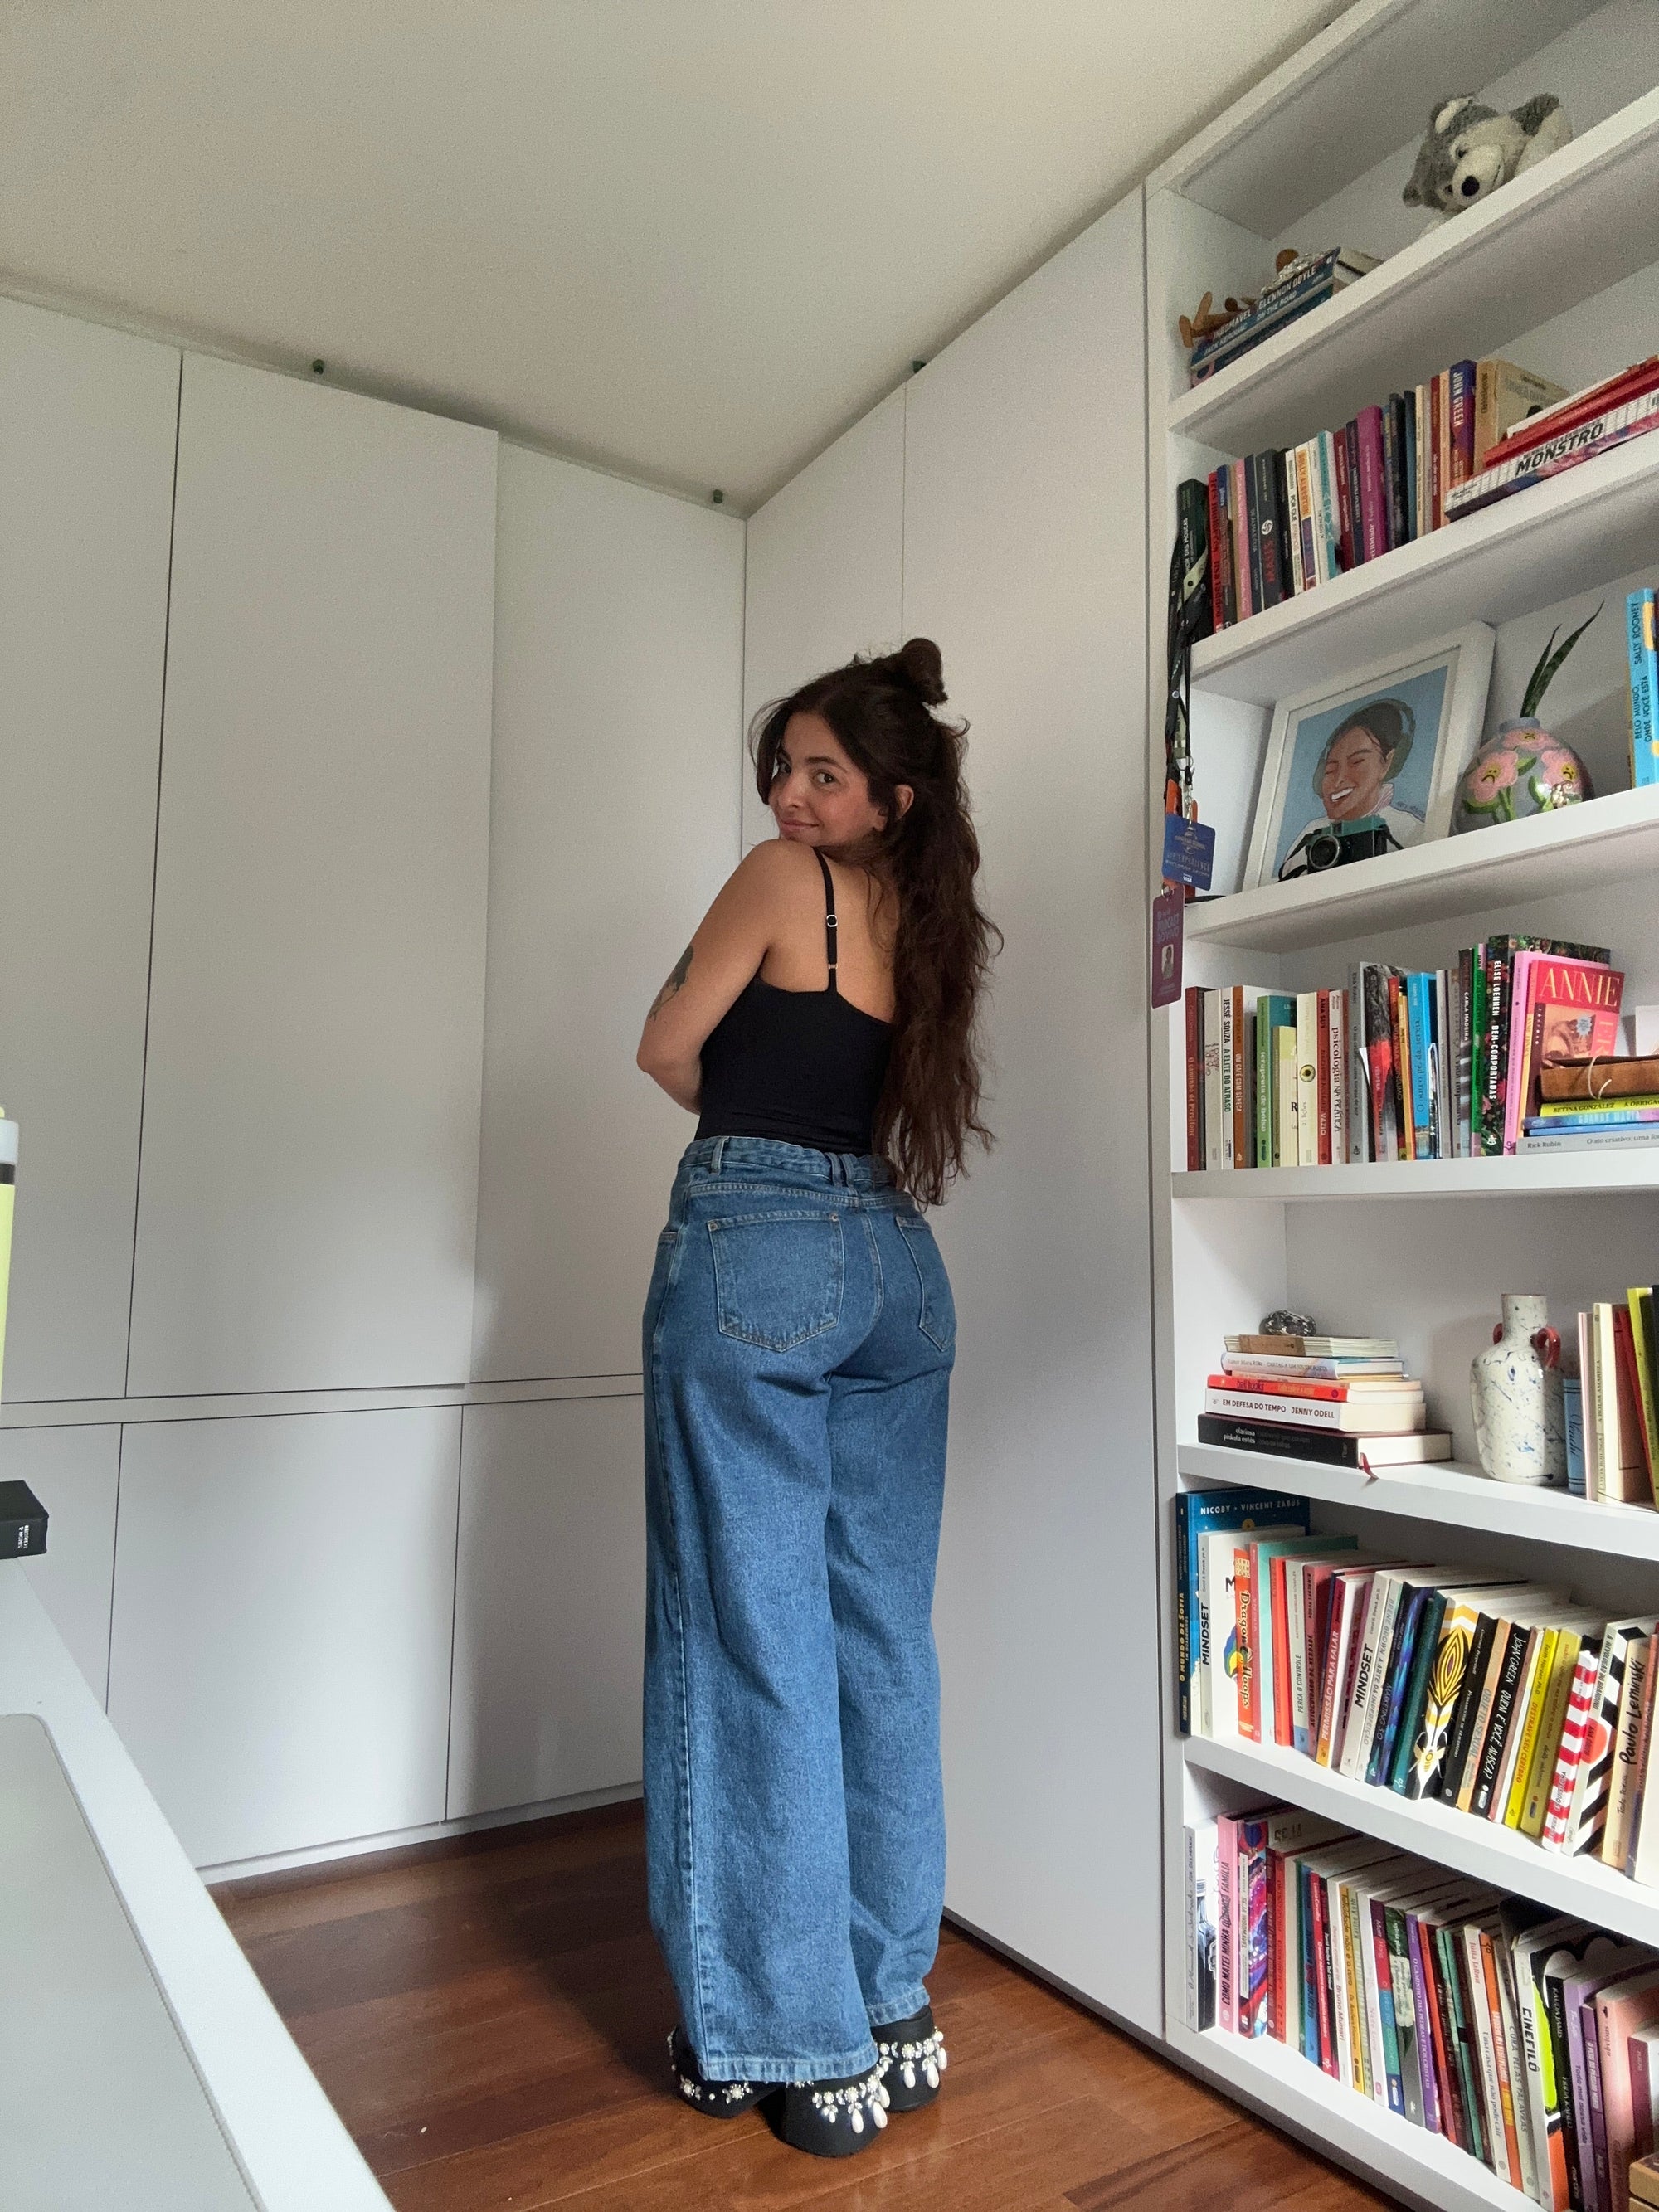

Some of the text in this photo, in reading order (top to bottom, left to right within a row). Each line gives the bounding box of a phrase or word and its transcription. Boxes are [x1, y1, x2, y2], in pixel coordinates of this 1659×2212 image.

[1453, 372, 1464, 427] JOHN GREEN
[1515, 423, 1603, 476] MONSTRO
[1631, 601, 1642, 641] ROONEY
[1633, 720, 1642, 740] BELO
[1643, 720, 1652, 742] ONDE
[1492, 960, 1501, 1016] ELISE LOEHNEN
[1540, 967, 1622, 1007] ANNIE
[1223, 999, 1231, 1018] JESSÉ
[1331, 1027, 1342, 1083] psicologia
[1489, 1025, 1500, 1100] BEM-COMPORTADAS
[1224, 1075, 1231, 1084] DO
[1334, 1085, 1342, 1097] NA
[1261, 1095, 1267, 1106] de
[1553, 1106, 1575, 1114] BETINA
[1232, 1400, 1253, 1409] DEFESA
[1254, 1402, 1264, 1410] DO
[1265, 1403, 1287, 1412] TEMPO
[1291, 1407, 1312, 1417] JENNY
[1314, 1409, 1335, 1418] ODELL
[1200, 1500, 1300, 1515] NICOBY VINCENT ZABUS
[1201, 1602, 1210, 1666] MINDSET
[1379, 1625, 1390, 1655] BROWN
[1239, 1591, 1253, 1709] Dragon Hoops
[1506, 1632, 1527, 1685] JOHN GREEN
[1308, 1666, 1314, 1676] DE
[1321, 1631, 1340, 1740] PERMISSÃO PARA FALAR
[1355, 1642, 1374, 1709] MINDSET
[1374, 1663, 1383, 1683] ARTE
[1371, 1684, 1379, 1694] DA
[1497, 1688, 1512, 1714] QUEM
[1593, 1684, 1603, 1710] BRANDING
[1626, 1657, 1647, 1723] Leminski
[1379, 1683, 1393, 1727] MARKETING
[1525, 1700, 1538, 1737] DESTRAVE
[1469, 1687, 1492, 1758] OBJETO SEXUAL
[1521, 1737, 1530, 1752] SEU
[1619, 1726, 1640, 1766] Paulo
[1221, 1928, 1230, 1956] MINHA
[1377, 1940, 1385, 1958] Haig
[1221, 1957, 1231, 1981] MATEI
[1221, 1981, 1231, 2005] COMO
[1413, 1964, 1423, 1998] CAMINHO
[1423, 2059, 1431, 2089] CRISTAIS
[1522, 2007, 1540, 2072] CINEFILÔ
[1509, 2025, 1527, 2132] CURA PELAS PALAVRAS
[1491, 2100, 1500, 2121] pode
[1564, 2100, 1573, 2129] KAHLO
